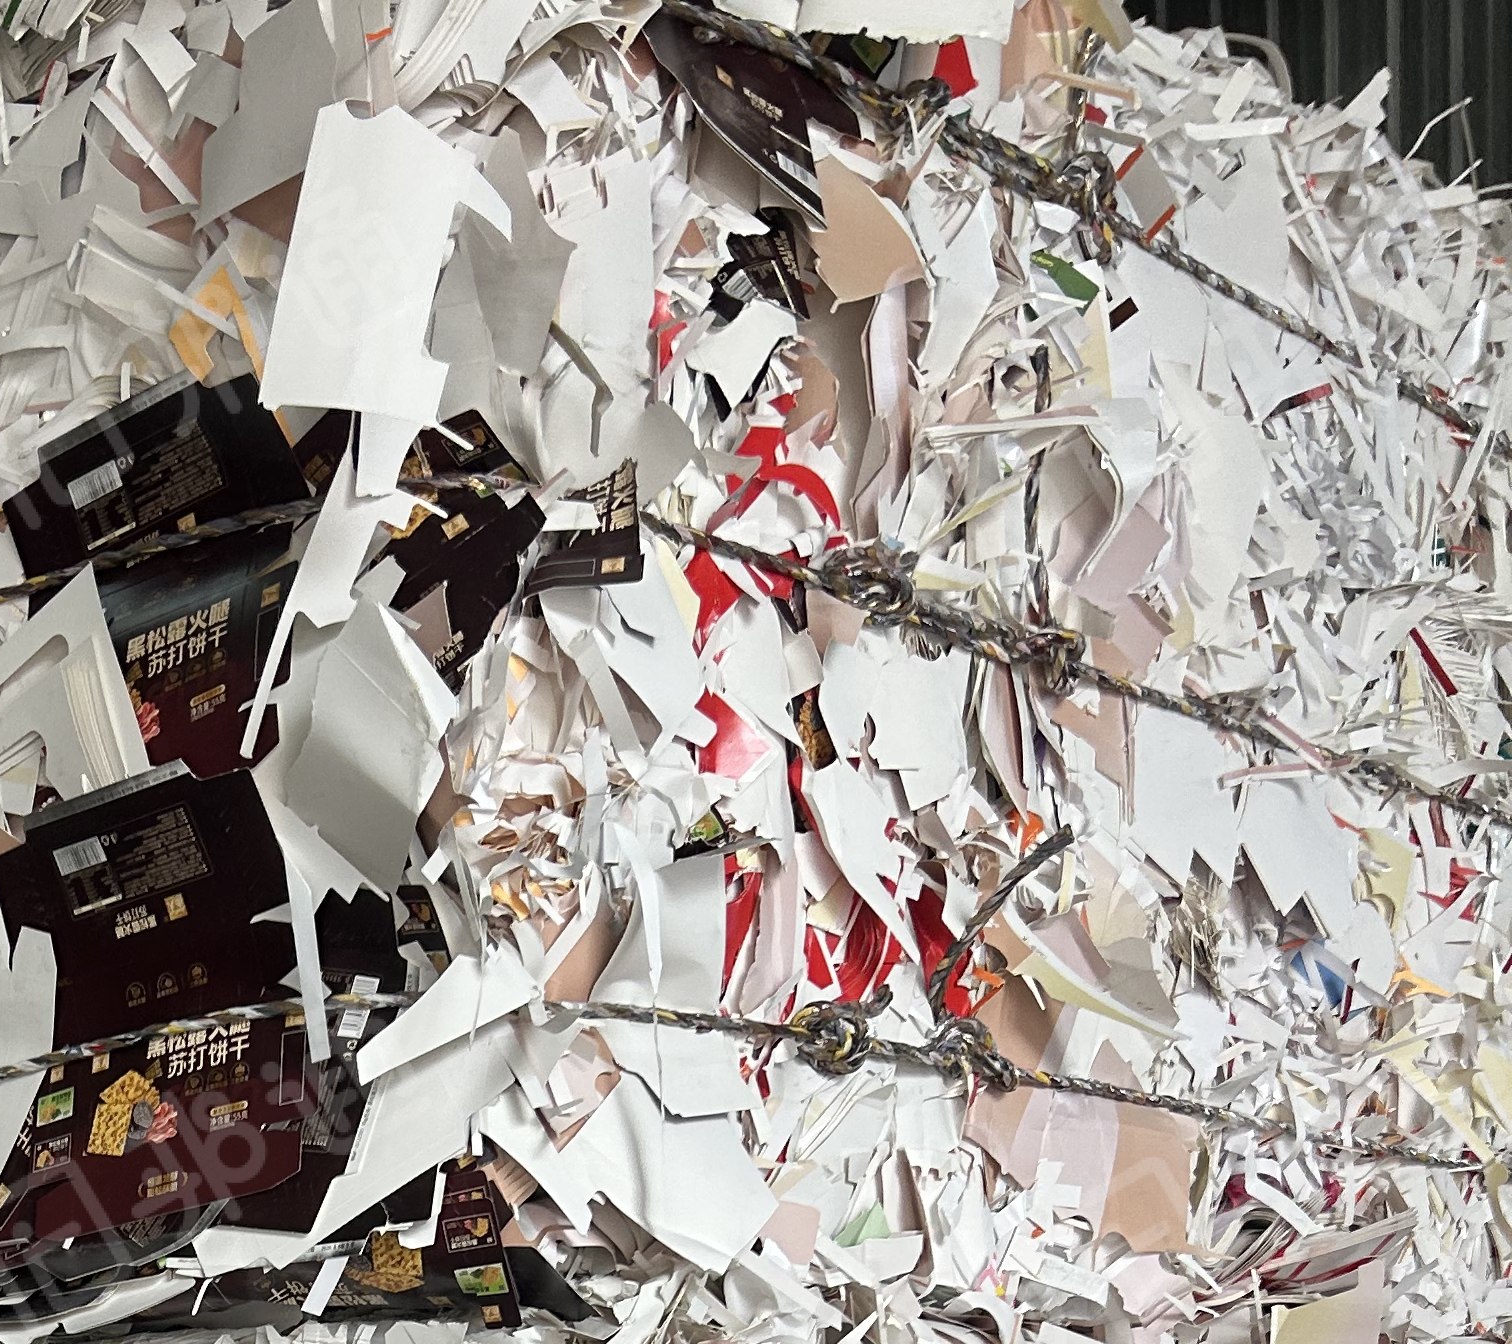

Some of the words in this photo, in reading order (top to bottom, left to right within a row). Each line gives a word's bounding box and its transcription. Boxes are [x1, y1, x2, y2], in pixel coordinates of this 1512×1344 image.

[125, 597, 232, 664] 黑松露火腿
[147, 622, 229, 679] 苏打饼干
[167, 1034, 250, 1079] 苏打饼干
